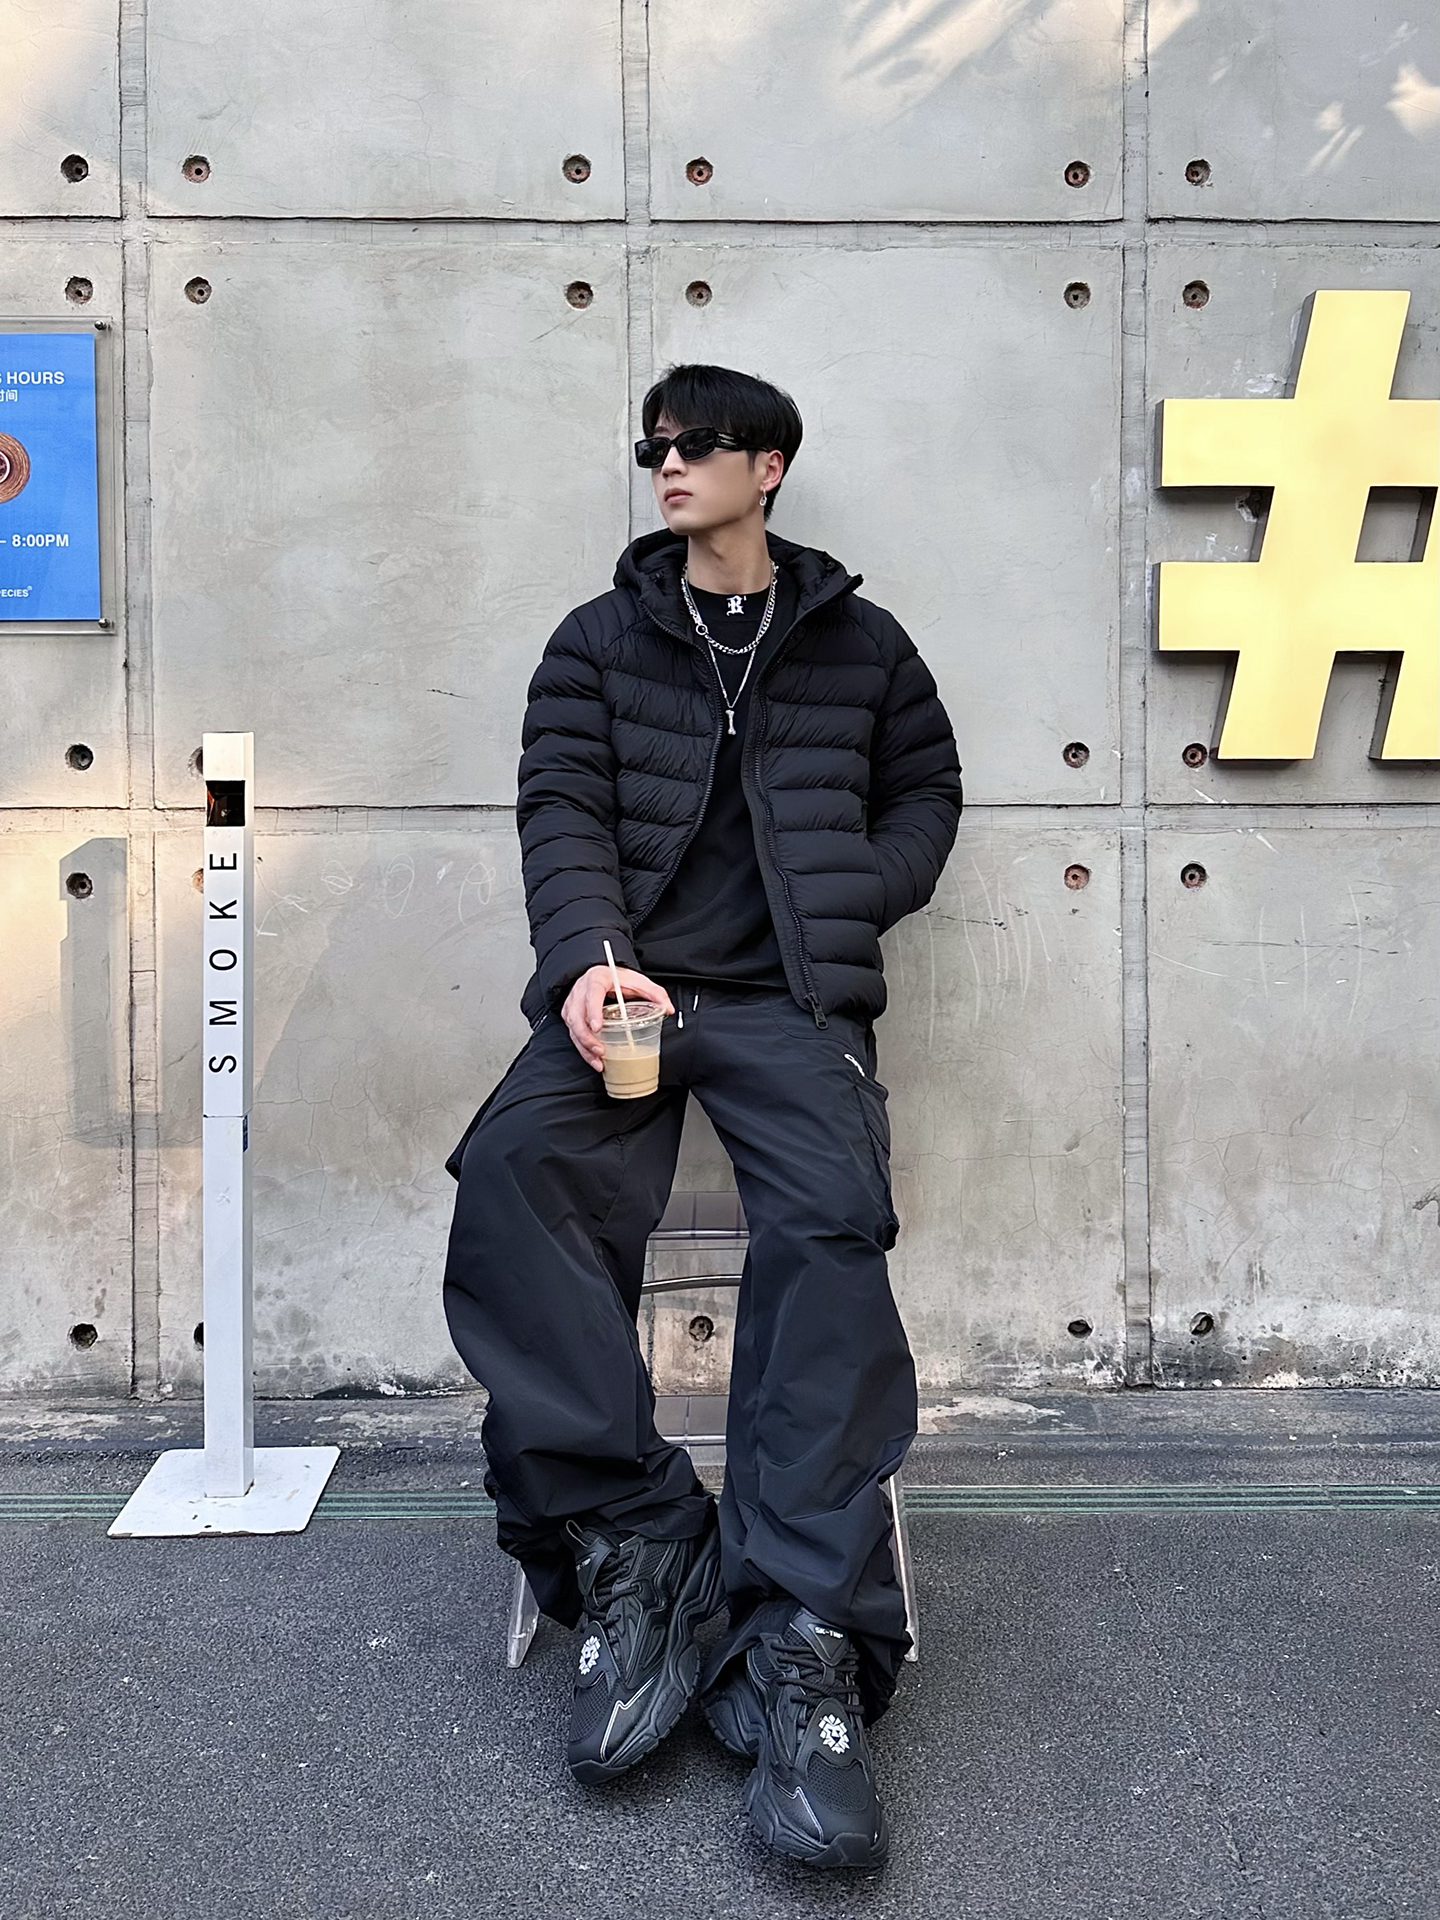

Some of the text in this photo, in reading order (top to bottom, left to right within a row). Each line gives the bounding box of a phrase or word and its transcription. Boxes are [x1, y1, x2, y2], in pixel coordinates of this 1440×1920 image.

[6, 371, 65, 385] HOURS
[12, 534, 69, 547] 8:00PM
[208, 852, 238, 1074] SMOKE
